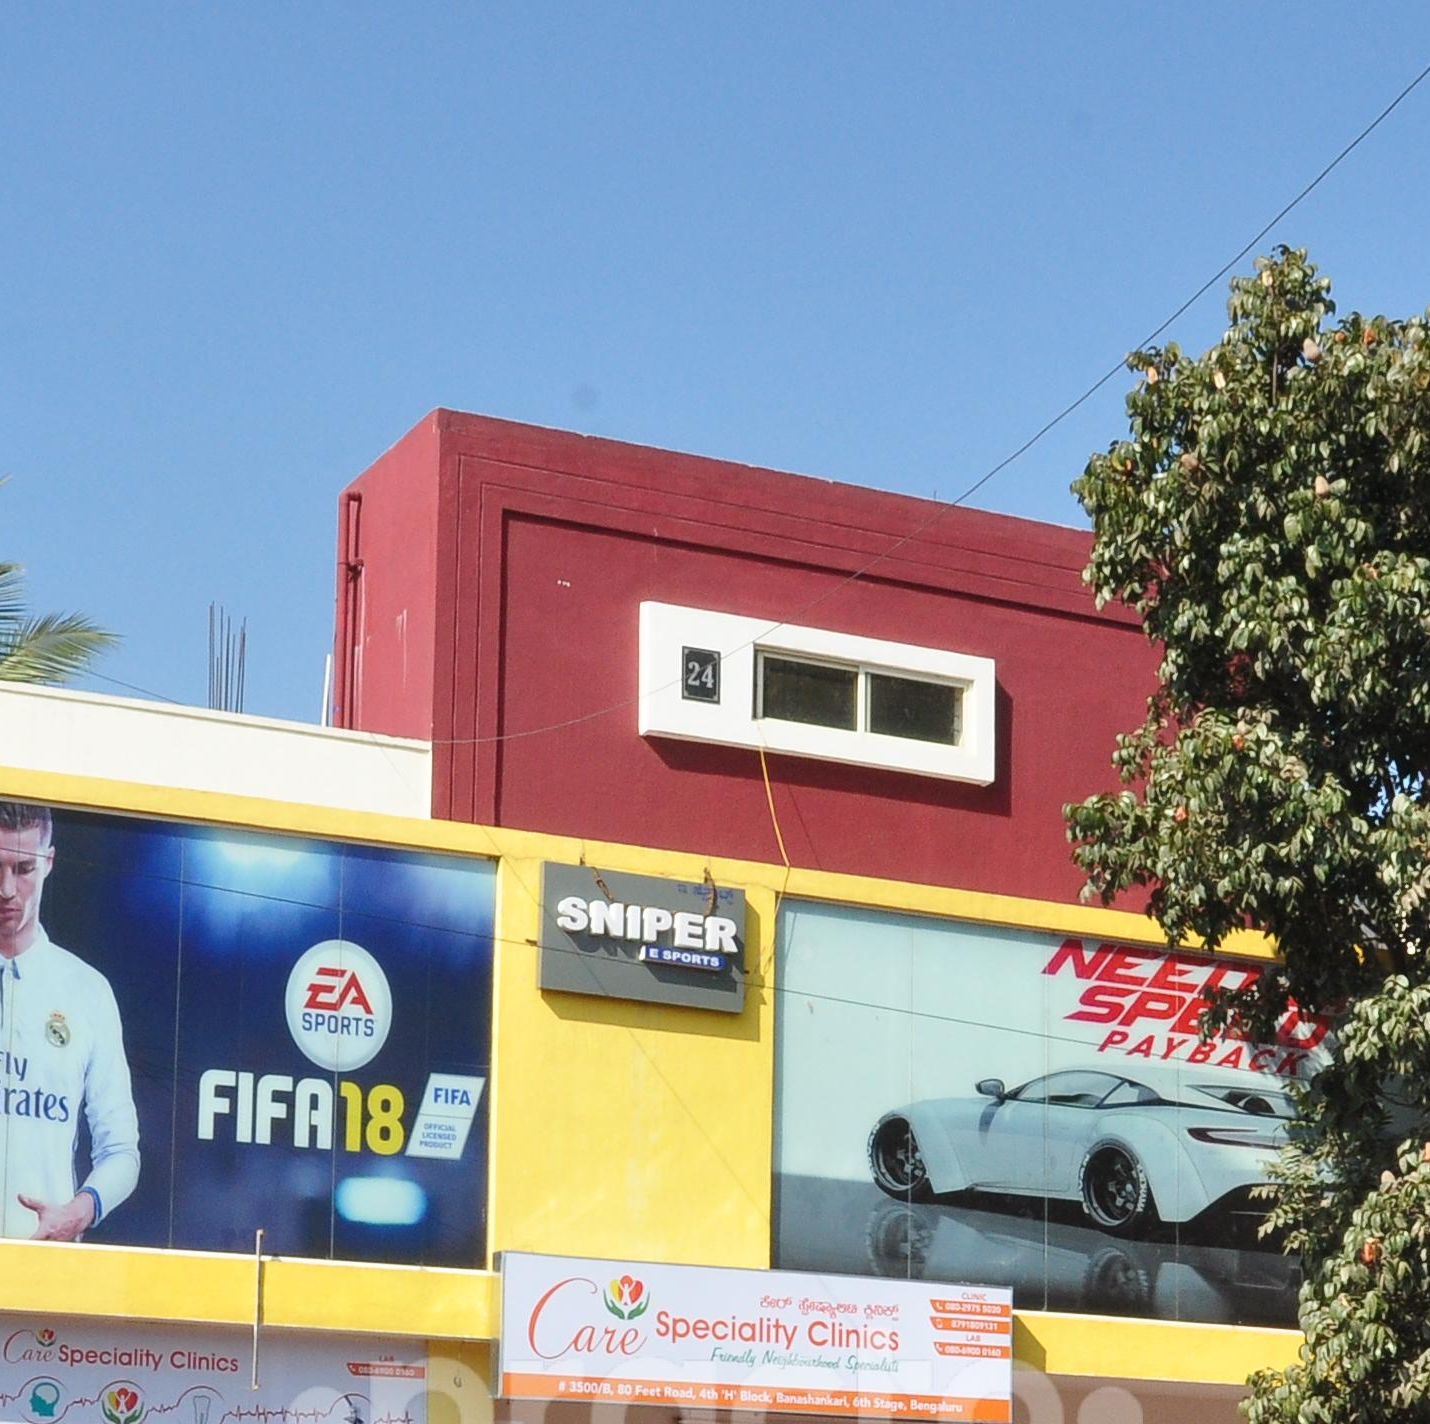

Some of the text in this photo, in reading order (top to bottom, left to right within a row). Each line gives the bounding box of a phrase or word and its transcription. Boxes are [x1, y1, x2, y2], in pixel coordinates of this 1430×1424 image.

[688, 661, 714, 688] 24
[557, 897, 738, 952] SNIPER
[649, 949, 720, 967] E SPORTS
[1041, 939, 1264, 993] NEED
[304, 968, 373, 1015] EA
[302, 1013, 374, 1036] SPORTS
[1097, 1030, 1308, 1076] PAYBACK
[434, 1088, 471, 1106] FIFA
[197, 1069, 405, 1155] FIFA 18
[420, 1140, 452, 1149] PRODUCT
[423, 1132, 457, 1140] LICENSED
[962, 1292, 987, 1300] CLINIC
[529, 1278, 899, 1360] Care Speciality Clinics
[3, 1329, 239, 1372] Care Speciality Clinics
[966, 1334, 981, 1342] LAB
[711, 1348, 755, 1367] Friendly
[762, 1350, 841, 1370] Neighbourhood
[558, 1382, 565, 1392] #
[569, 1381, 613, 1396] 3500/B,
[617, 1384, 631, 1394] 80
[635, 1384, 661, 1396] Feet
[665, 1386, 695, 1400] Road,
[699, 1388, 717, 1400] 4th
[741, 1390, 773, 1404] Block,
[777, 1393, 850, 1408] Banashankari,
[853, 1396, 871, 1407] 6th
[873, 1398, 907, 1413] Stage,
[911, 1400, 963, 1415] Bengaluru
